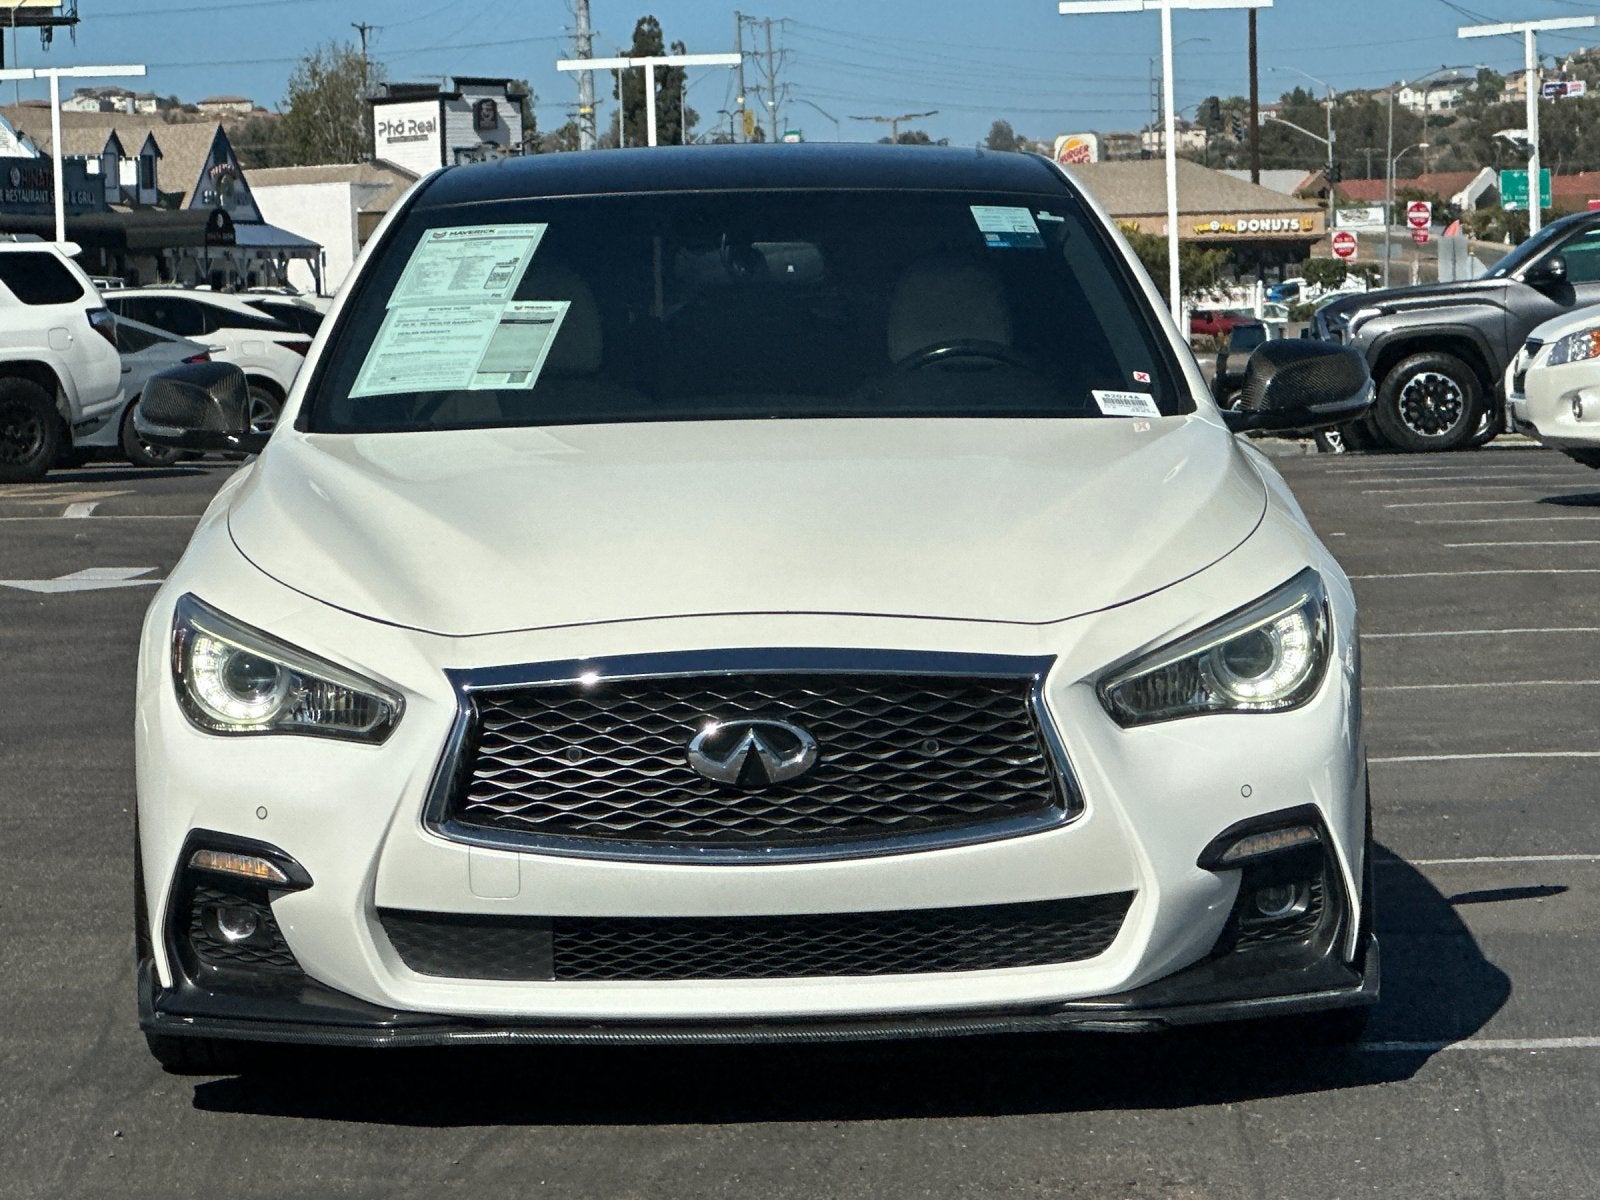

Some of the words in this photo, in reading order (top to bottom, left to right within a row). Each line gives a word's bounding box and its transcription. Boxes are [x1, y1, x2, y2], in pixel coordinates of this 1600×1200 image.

[408, 116, 436, 135] Real
[1060, 144, 1089, 163] BURGER
[5, 189, 48, 203] RESTAURANT
[1237, 219, 1299, 232] DONUTS
